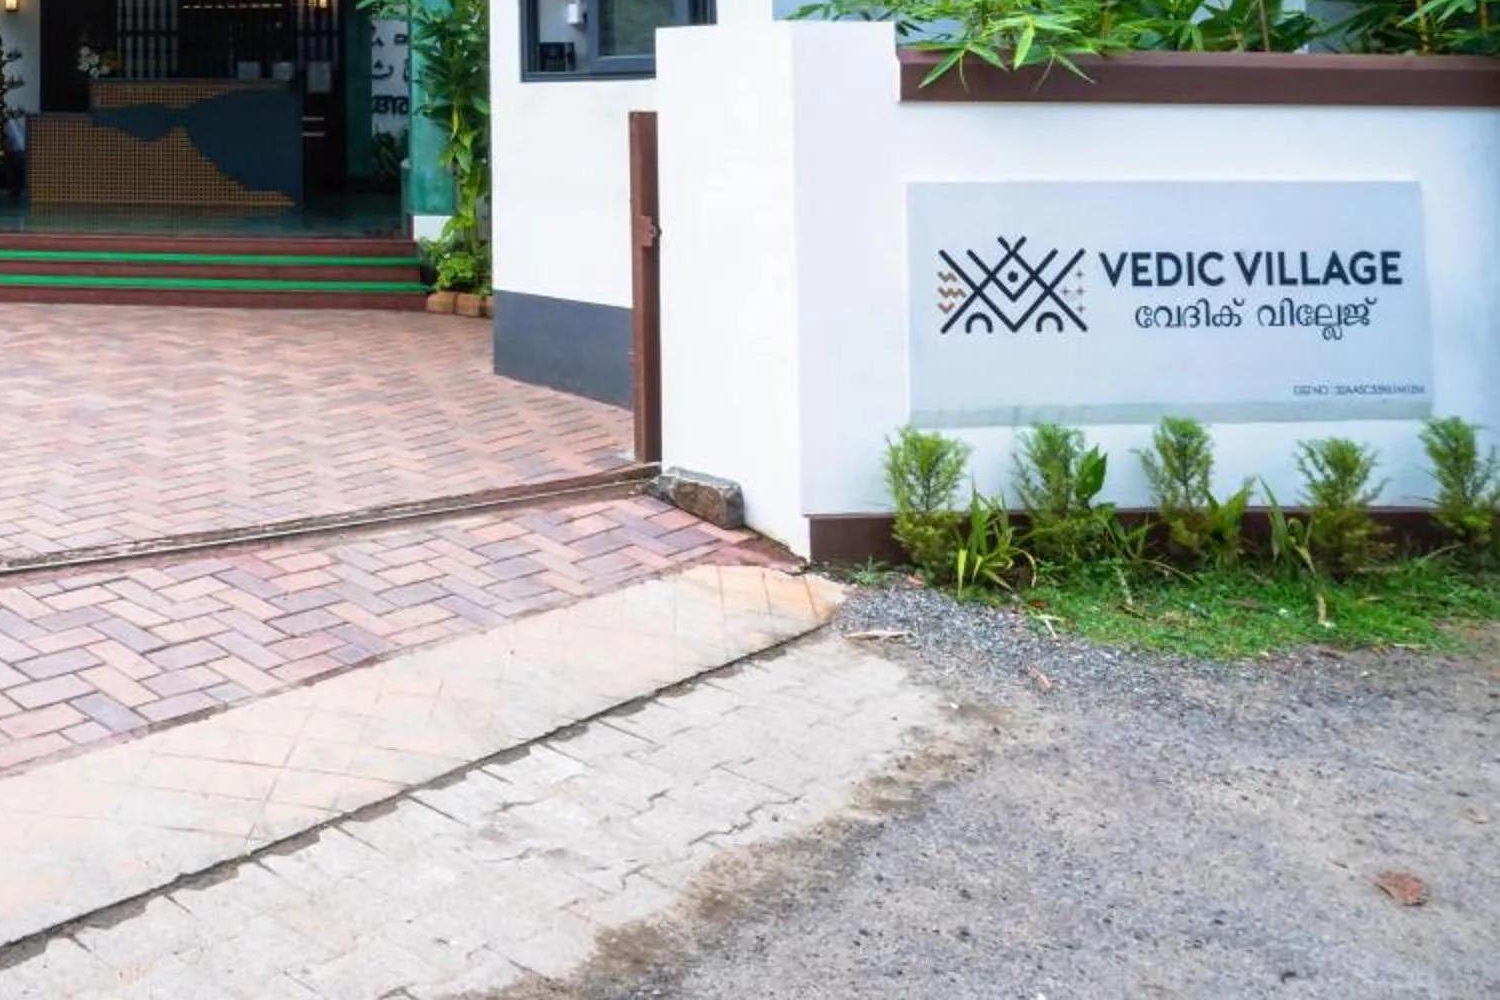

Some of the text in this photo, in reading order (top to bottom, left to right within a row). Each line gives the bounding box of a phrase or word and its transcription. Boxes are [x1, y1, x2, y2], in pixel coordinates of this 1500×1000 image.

[1099, 250, 1403, 287] VEDIC VILLAGE
[1135, 297, 1377, 341] വേദിക് വില്ലേജ്
